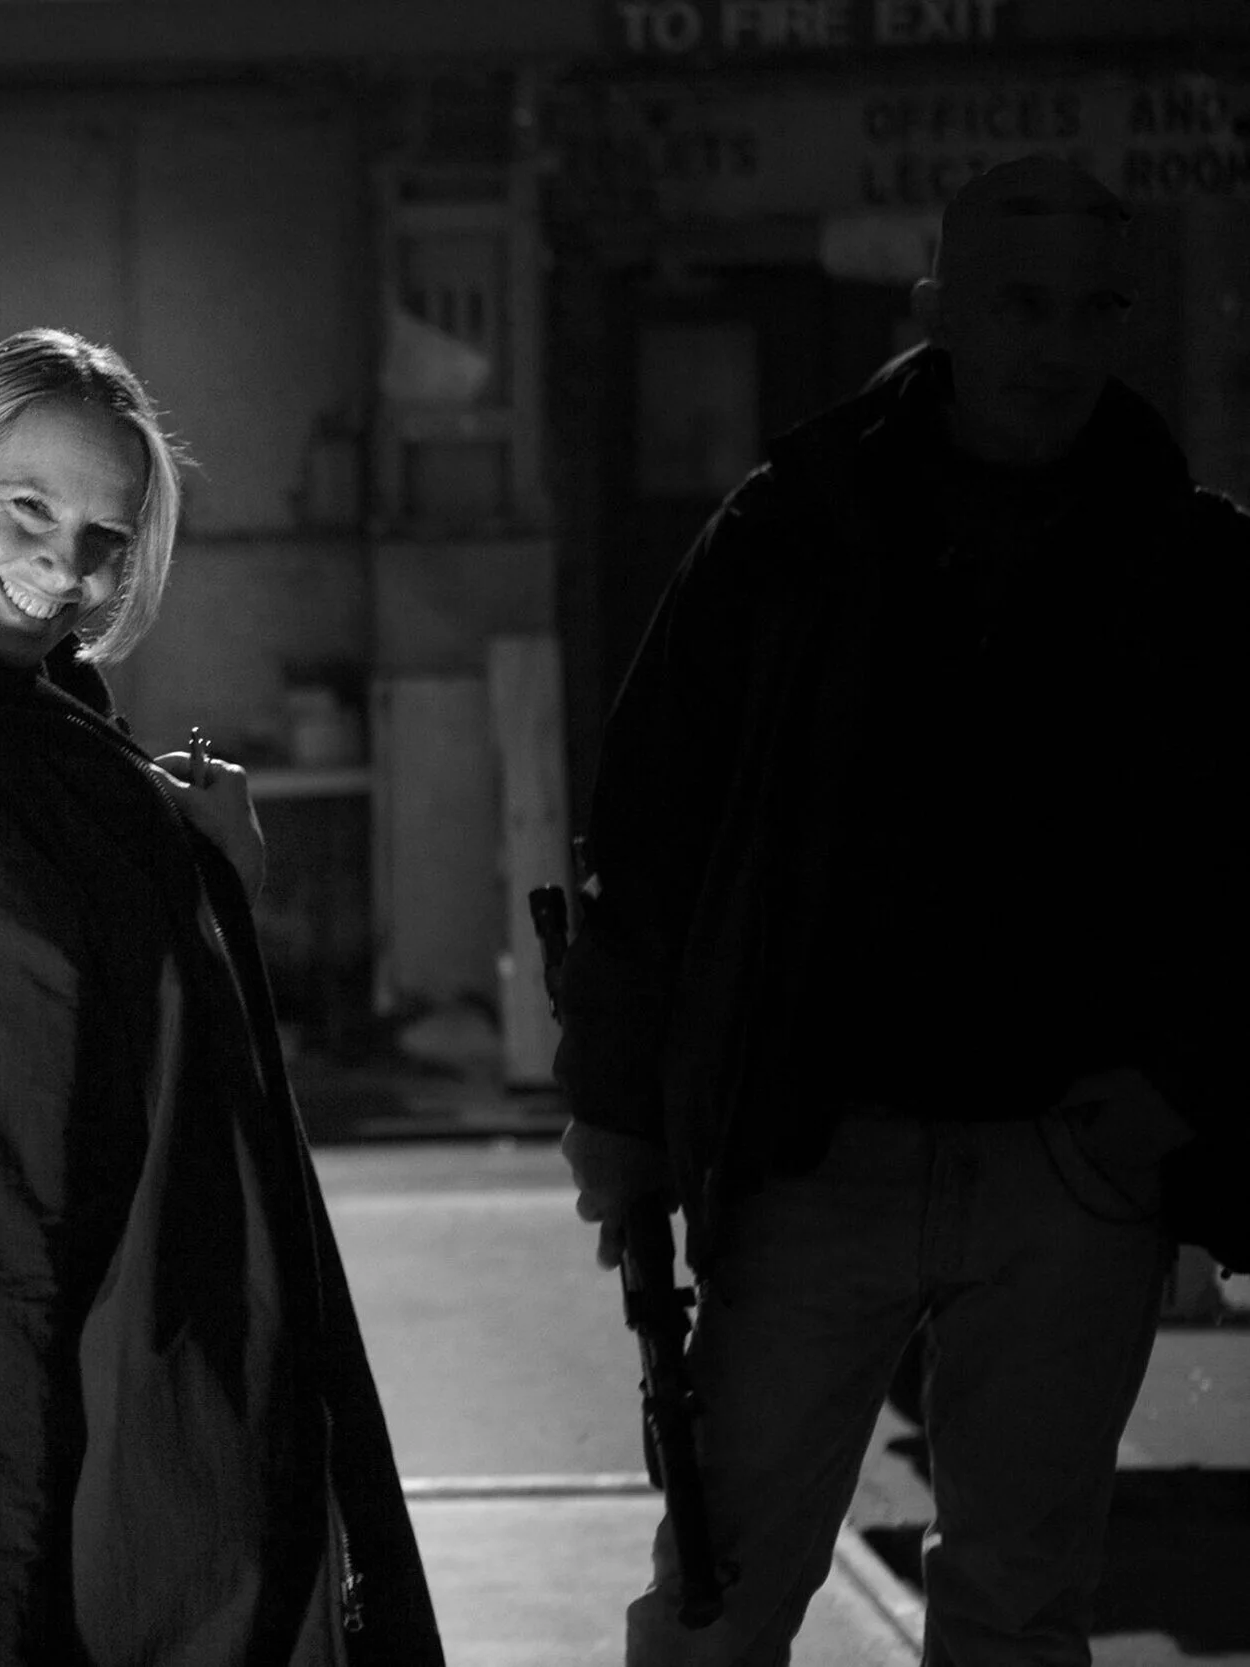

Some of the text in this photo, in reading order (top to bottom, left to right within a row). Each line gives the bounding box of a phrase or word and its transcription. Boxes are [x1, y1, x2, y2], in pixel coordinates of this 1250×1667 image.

[617, 0, 1007, 53] TO FIRE EXIT
[863, 93, 1081, 144] OFFICES
